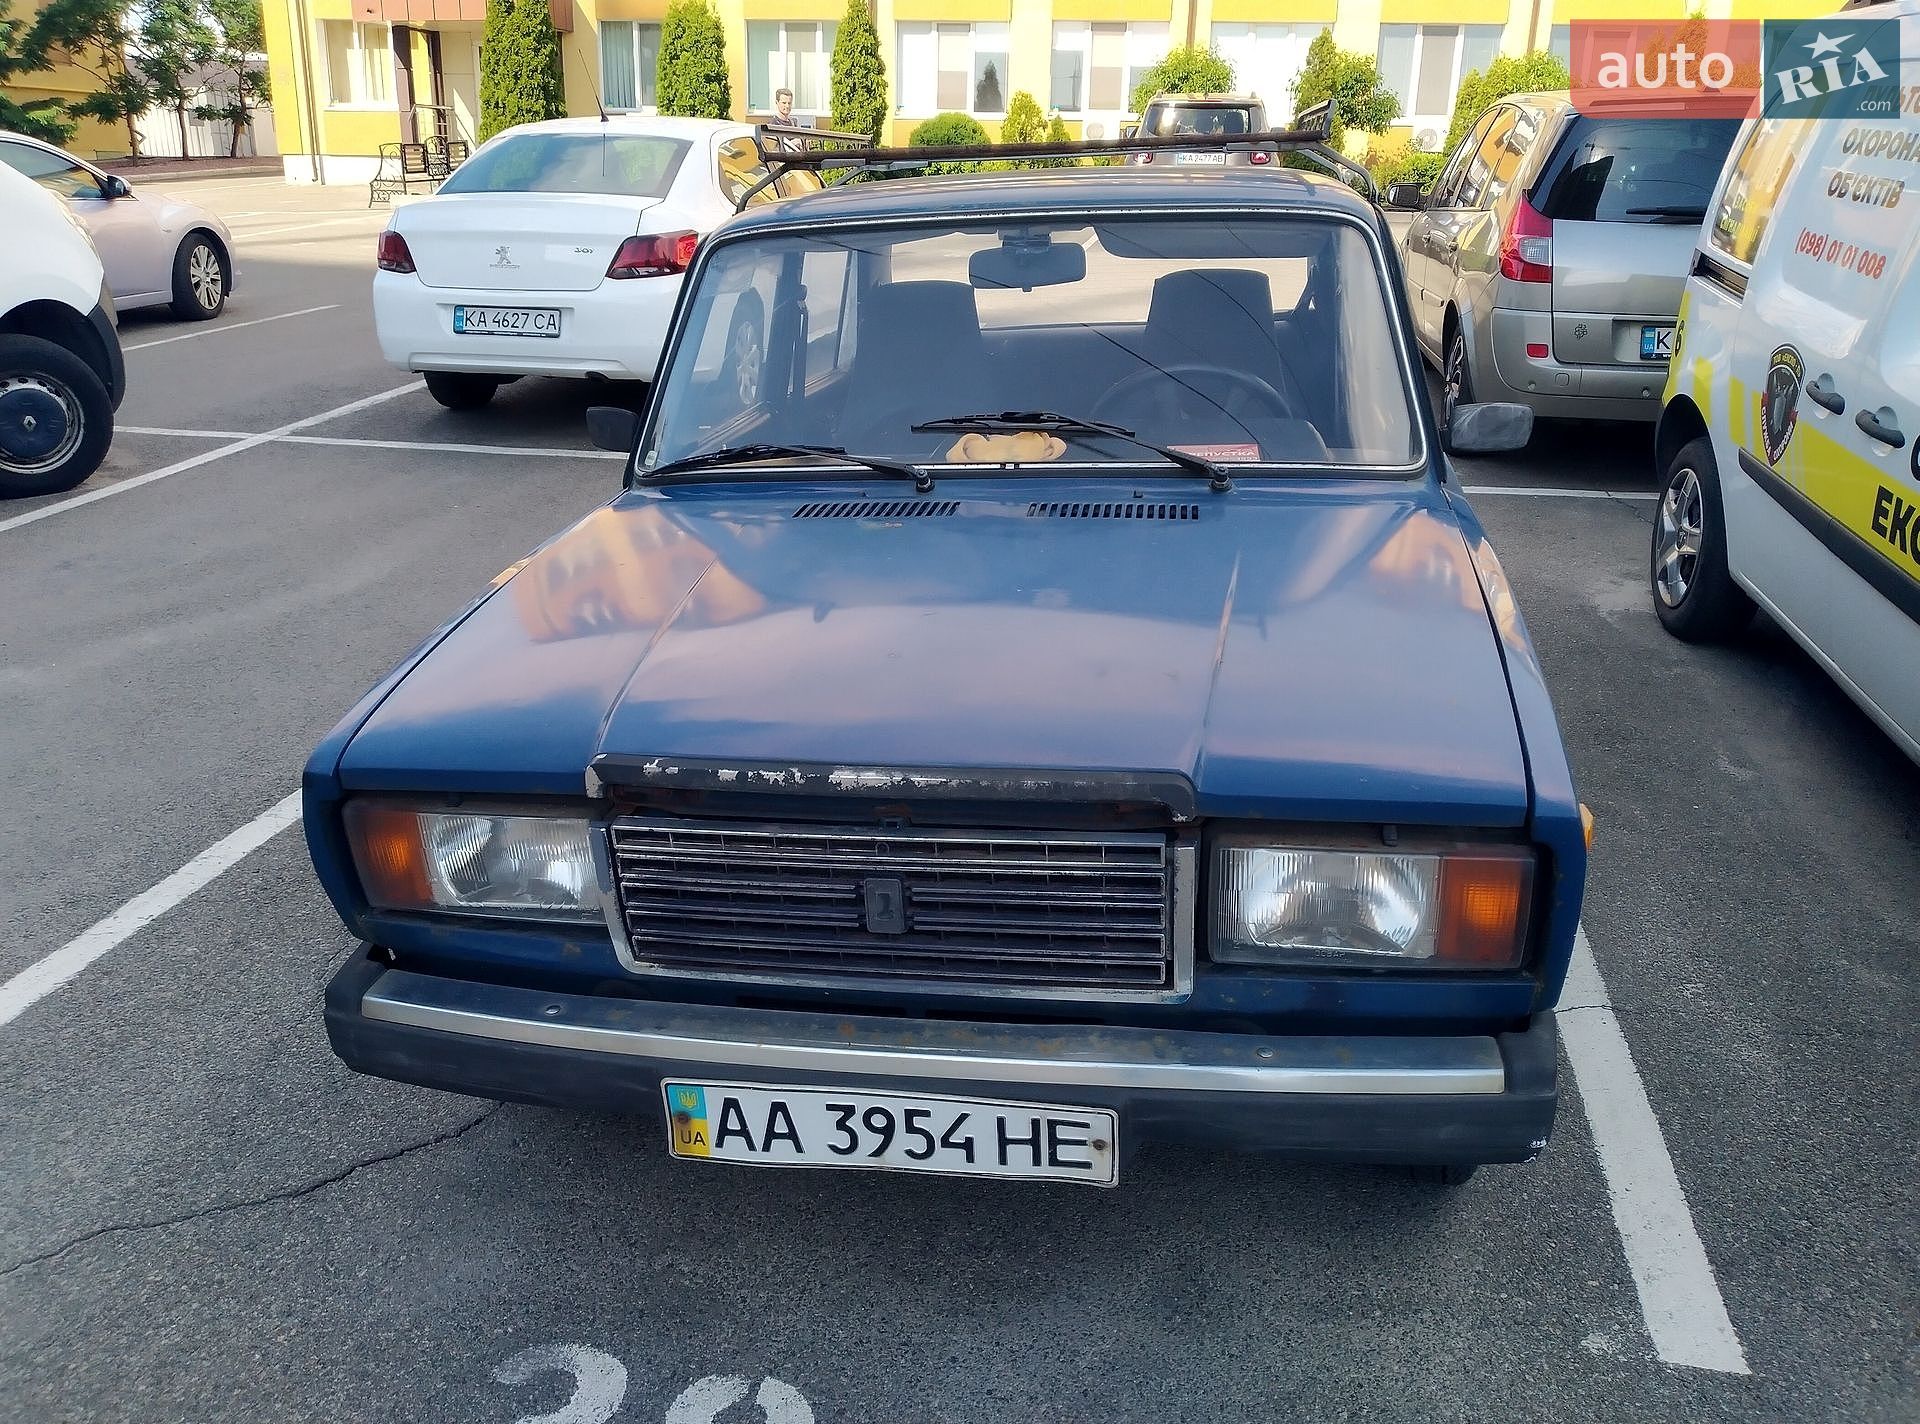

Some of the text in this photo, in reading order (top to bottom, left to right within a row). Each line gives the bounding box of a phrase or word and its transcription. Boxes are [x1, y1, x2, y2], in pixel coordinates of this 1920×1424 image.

[1795, 227, 1886, 279] (098) 01 01 008
[464, 310, 557, 330] KA 4627 CA
[680, 1129, 706, 1147] UA
[714, 1096, 1094, 1170] AA 3954 HE
